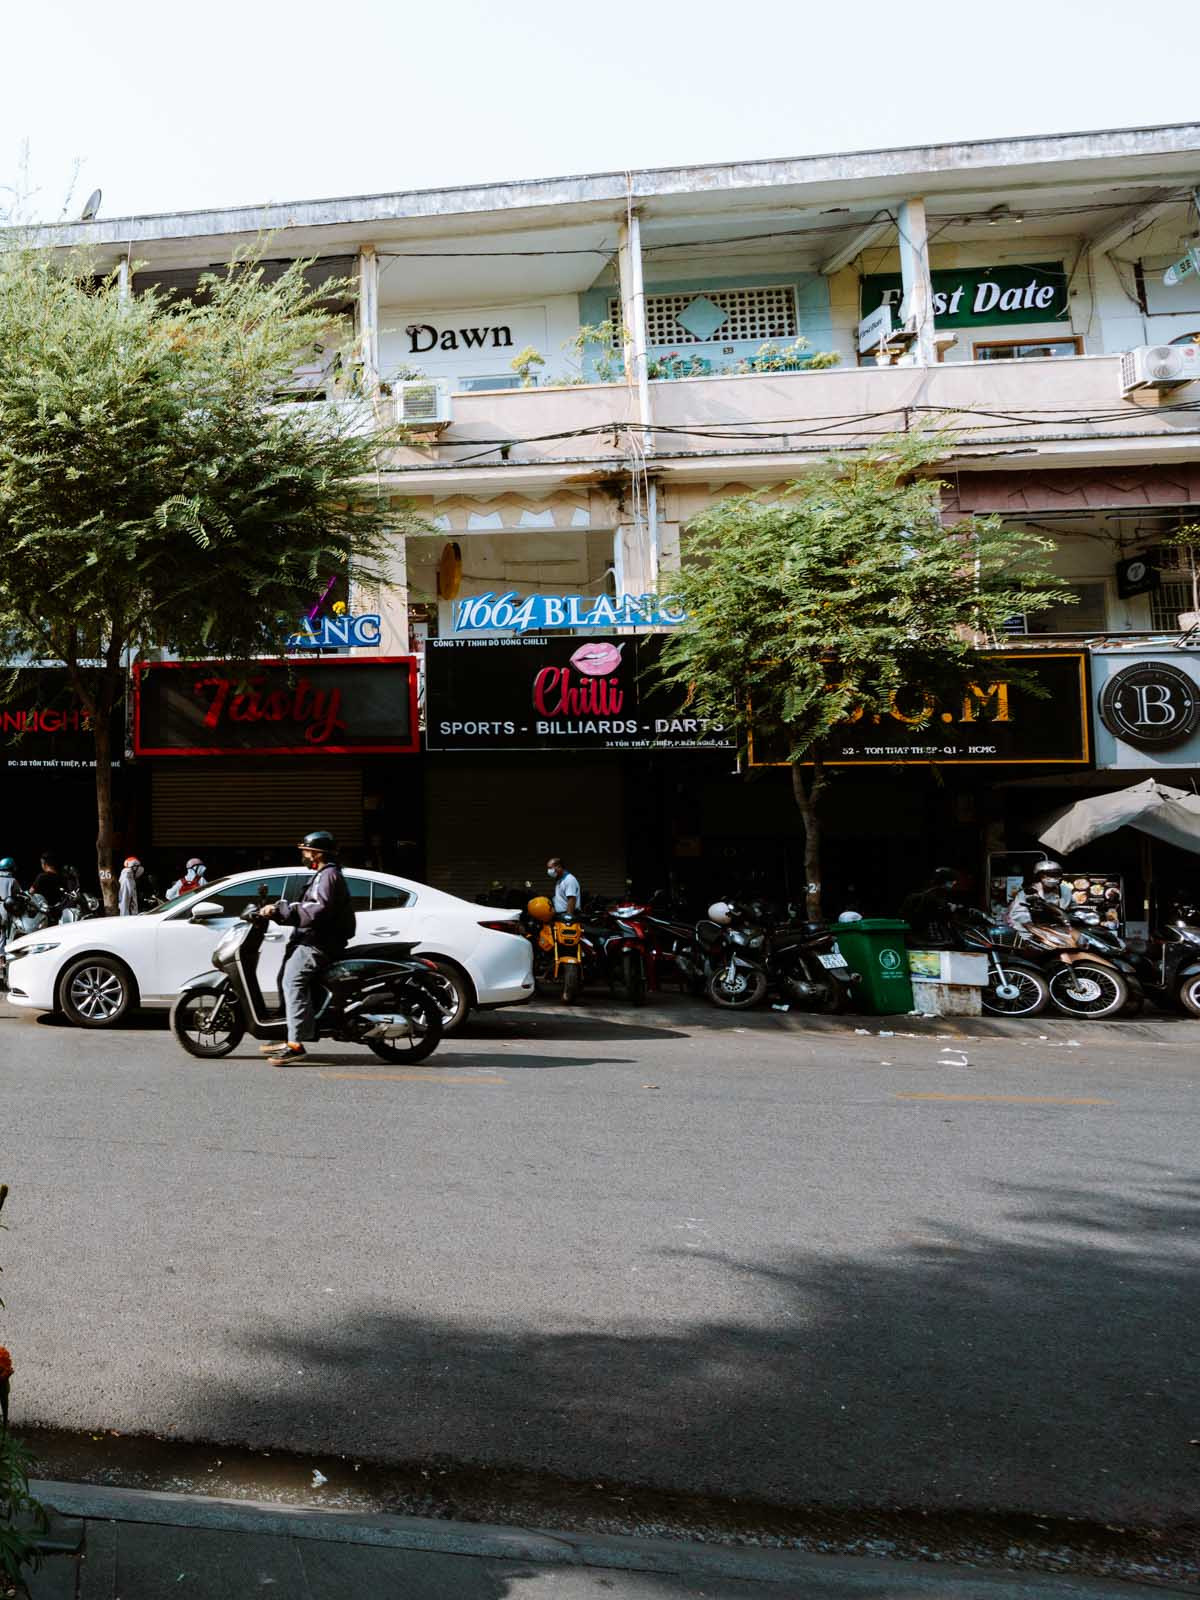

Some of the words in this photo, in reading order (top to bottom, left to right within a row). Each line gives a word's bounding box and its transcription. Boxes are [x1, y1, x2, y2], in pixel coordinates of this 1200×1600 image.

[881, 285, 965, 318] Fst
[973, 279, 1055, 313] Date
[409, 323, 514, 354] Dawn
[289, 616, 381, 645] ANC
[456, 592, 538, 631] 1664
[193, 678, 349, 743] Tasty
[532, 665, 624, 718] Chilli
[1130, 684, 1176, 725] B
[439, 721, 515, 736] SPORTS
[536, 719, 637, 735] BILLIARDS
[655, 719, 724, 733] DARTS
[864, 746, 884, 754] TON
[968, 745, 997, 754] HCMC
